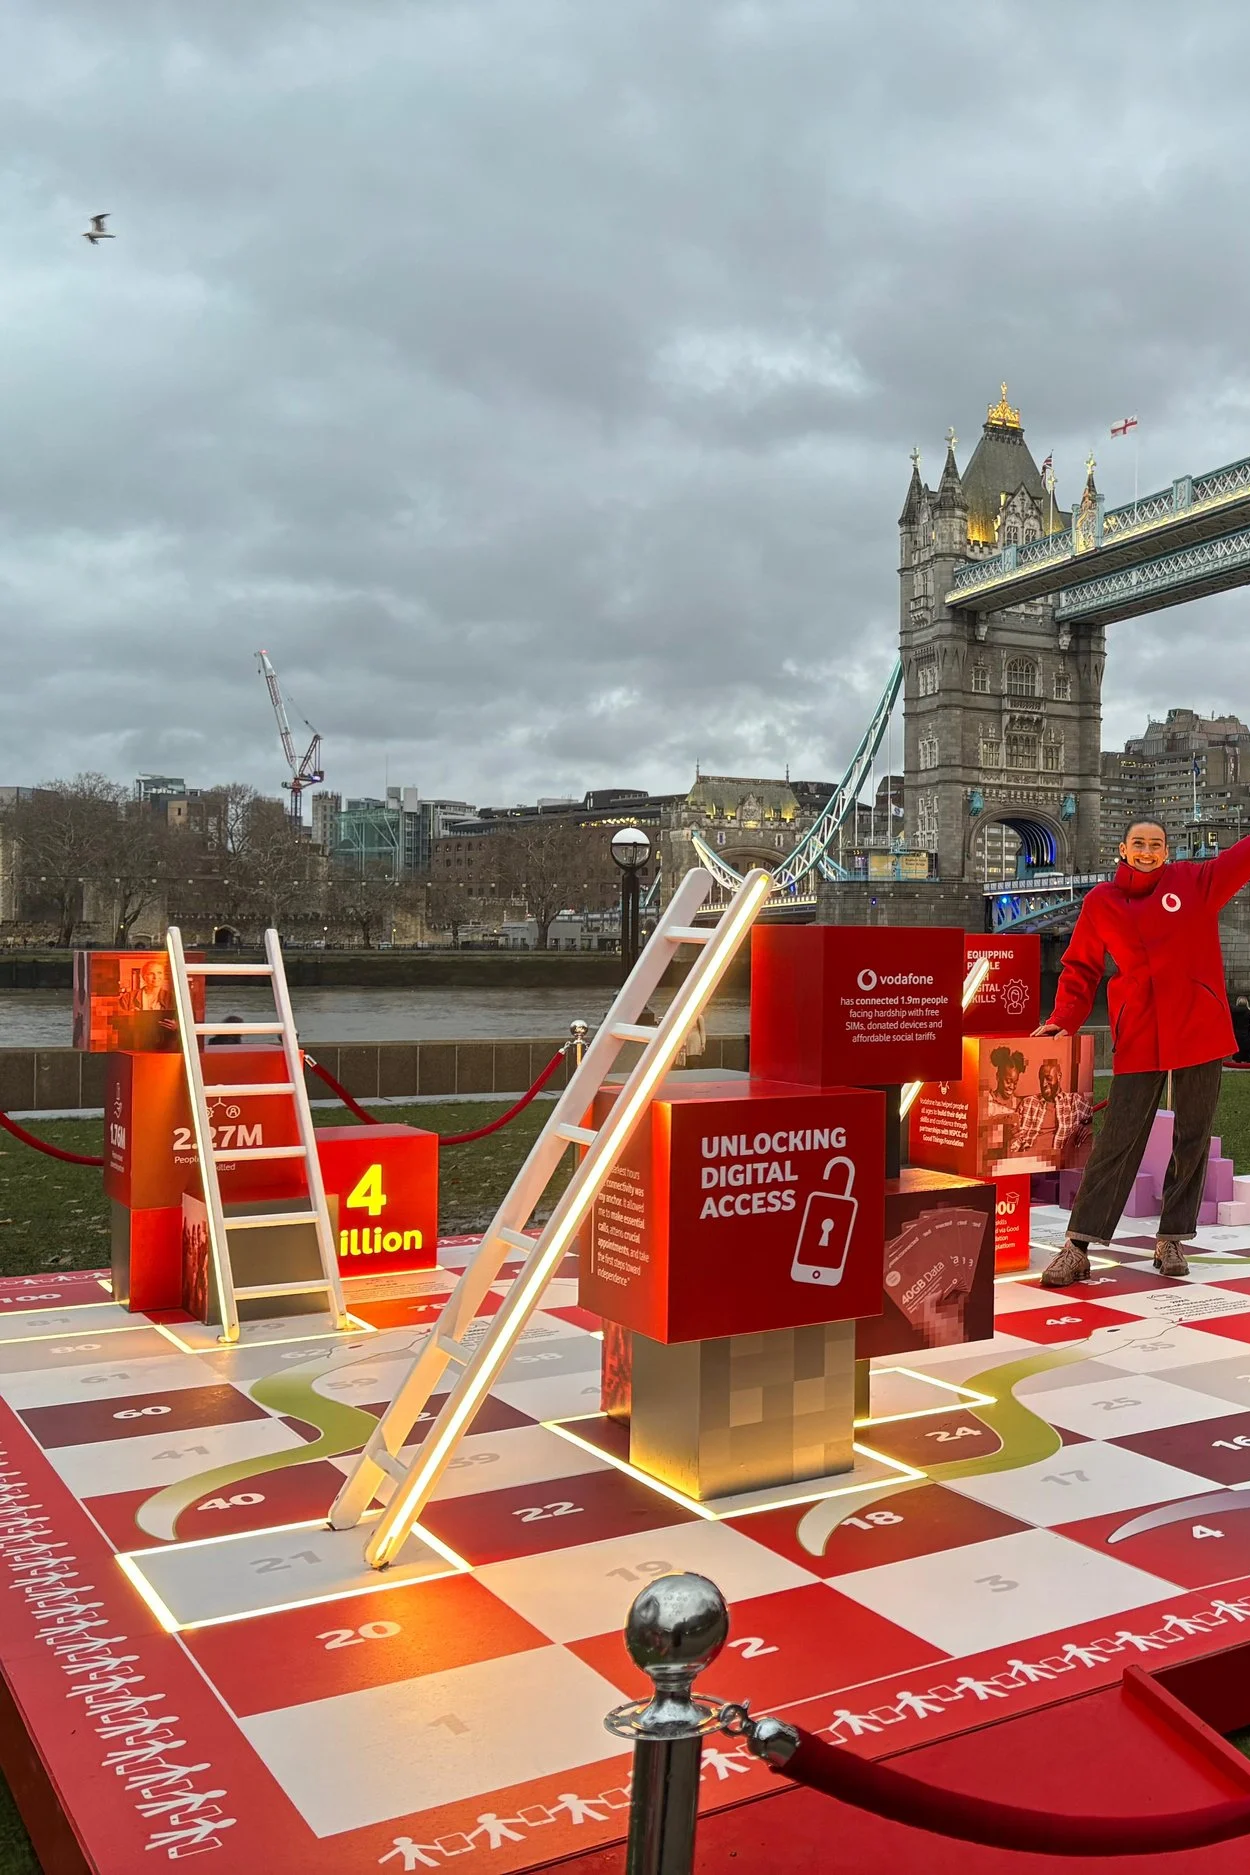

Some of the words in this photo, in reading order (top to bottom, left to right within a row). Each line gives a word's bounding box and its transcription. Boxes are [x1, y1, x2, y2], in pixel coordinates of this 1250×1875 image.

[967, 950, 1014, 960] EQUIPPING
[880, 973, 934, 985] vodafone
[840, 996, 855, 1006] has
[855, 996, 899, 1005] connected
[900, 996, 920, 1005] 1.9m
[921, 995, 949, 1008] people
[972, 994, 997, 1004] KILLS
[849, 1009, 873, 1019] facing
[874, 1008, 907, 1018] hardship
[908, 1008, 925, 1017] with
[925, 1007, 940, 1016] free
[867, 1021, 899, 1030] donated
[900, 1020, 928, 1029] devices
[928, 1020, 943, 1029] and
[852, 1033, 890, 1043] affordable
[892, 1032, 914, 1041] social
[915, 1031, 936, 1041] tariffs
[701, 1127, 847, 1159] UNLOCKING
[701, 1160, 799, 1189] DIGITAL
[346, 1164, 387, 1216] 4
[699, 1189, 796, 1220] ACCESS
[340, 1227, 423, 1257] illion
[901, 1278, 926, 1305] 40GB
[923, 1261, 945, 1283] Data
[1045, 1315, 1084, 1327] 46
[113, 1405, 172, 1420] 60
[1090, 1395, 1142, 1412] 25
[924, 1425, 983, 1443] 24
[151, 1445, 210, 1461] 41
[1040, 1469, 1091, 1487] 17
[196, 1492, 266, 1511] 40
[511, 1501, 585, 1523] 22
[840, 1510, 905, 1531] 18
[1191, 1524, 1226, 1540] 4
[249, 1550, 322, 1575] 21
[605, 1559, 674, 1584] 19
[973, 1574, 1020, 1593] 3
[315, 1620, 403, 1651] 20
[727, 1636, 781, 1660] 2
[427, 1712, 471, 1737] 1
